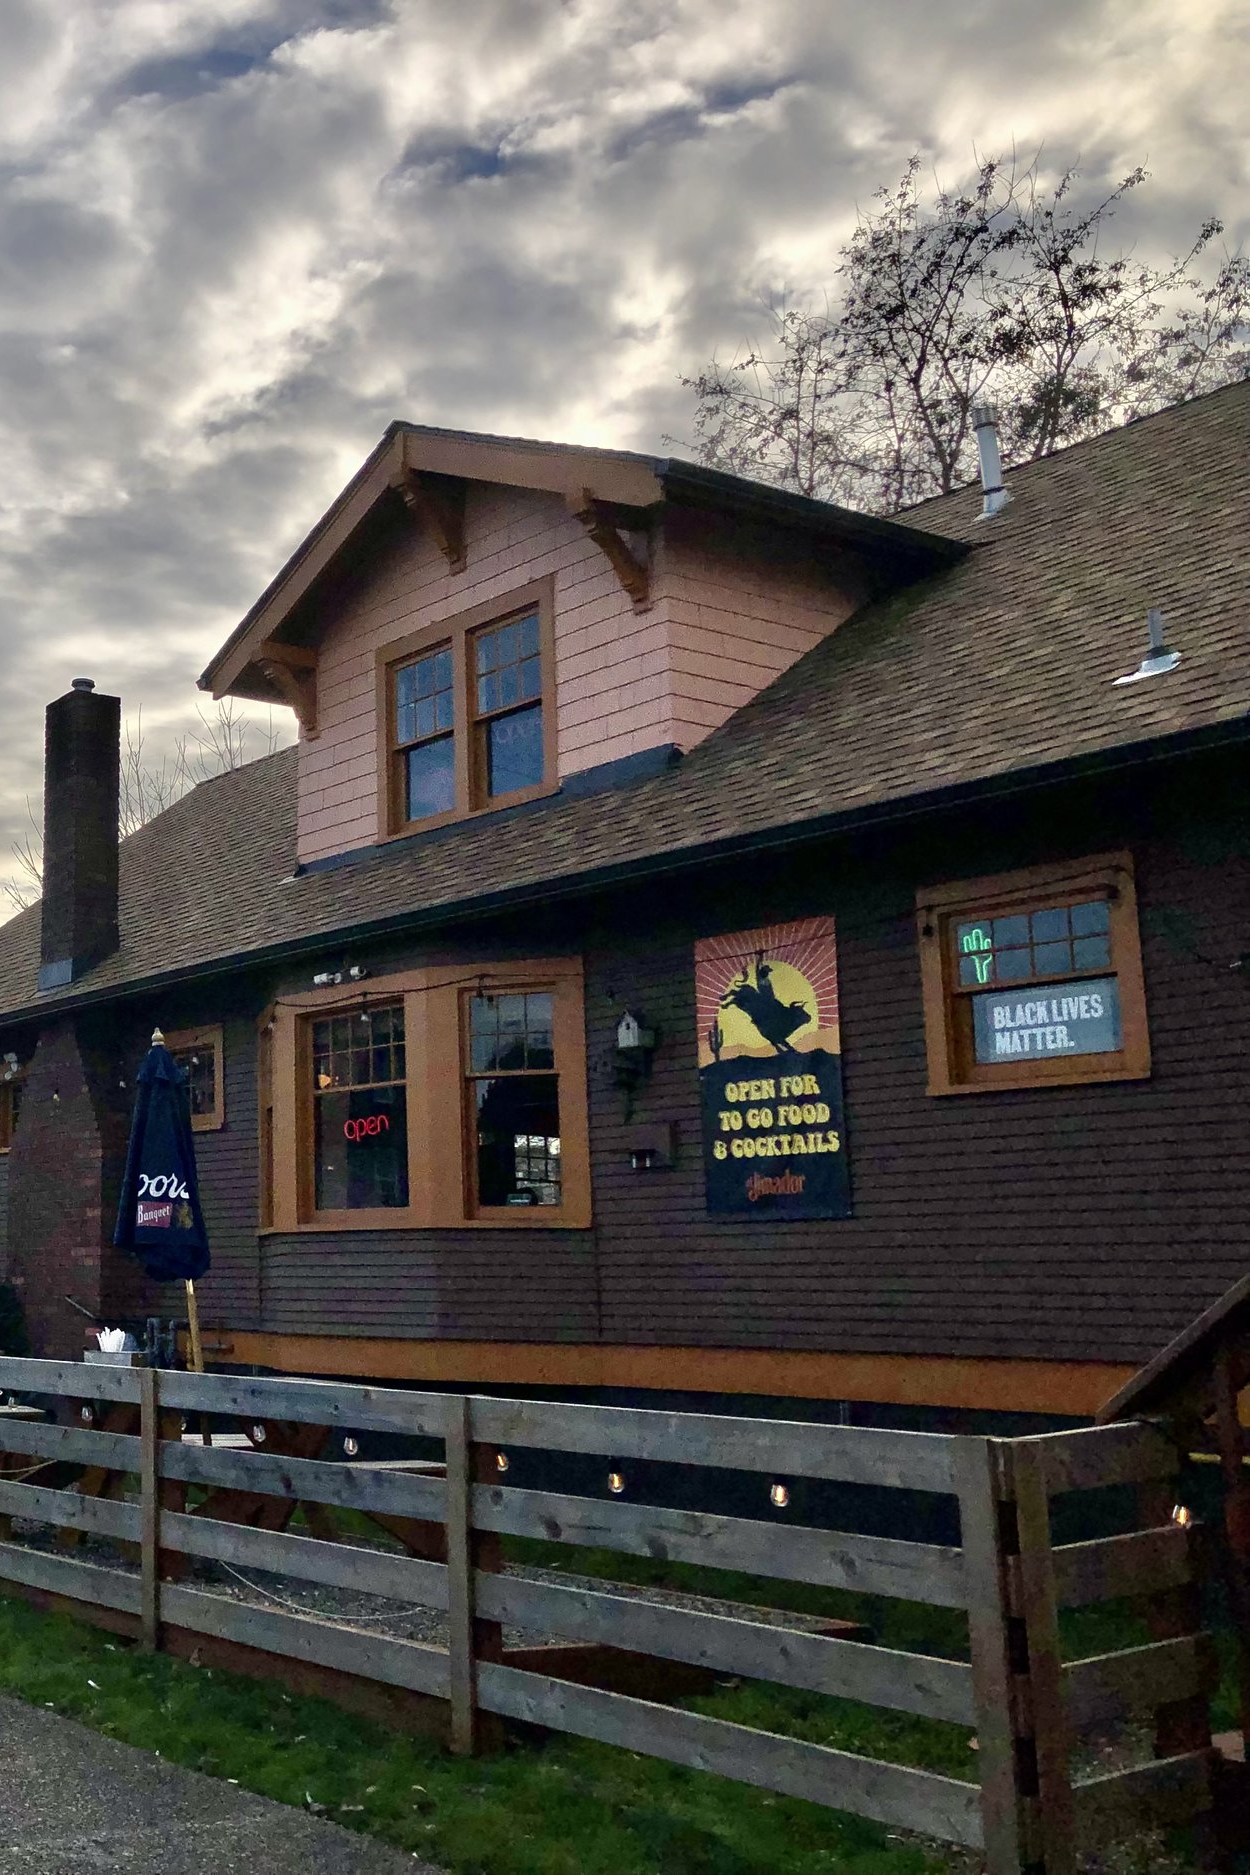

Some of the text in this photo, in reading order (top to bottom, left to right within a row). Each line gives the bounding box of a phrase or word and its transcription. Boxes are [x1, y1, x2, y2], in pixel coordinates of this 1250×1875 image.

[993, 993, 1104, 1029] BLACK LIVES
[995, 1025, 1075, 1054] MATTER.
[725, 1073, 821, 1102] OPEN FOR
[343, 1114, 389, 1142] open
[718, 1102, 831, 1131] TO GO FOOD
[730, 1130, 840, 1158] COCKTAILS
[137, 1204, 170, 1223] Banquet
